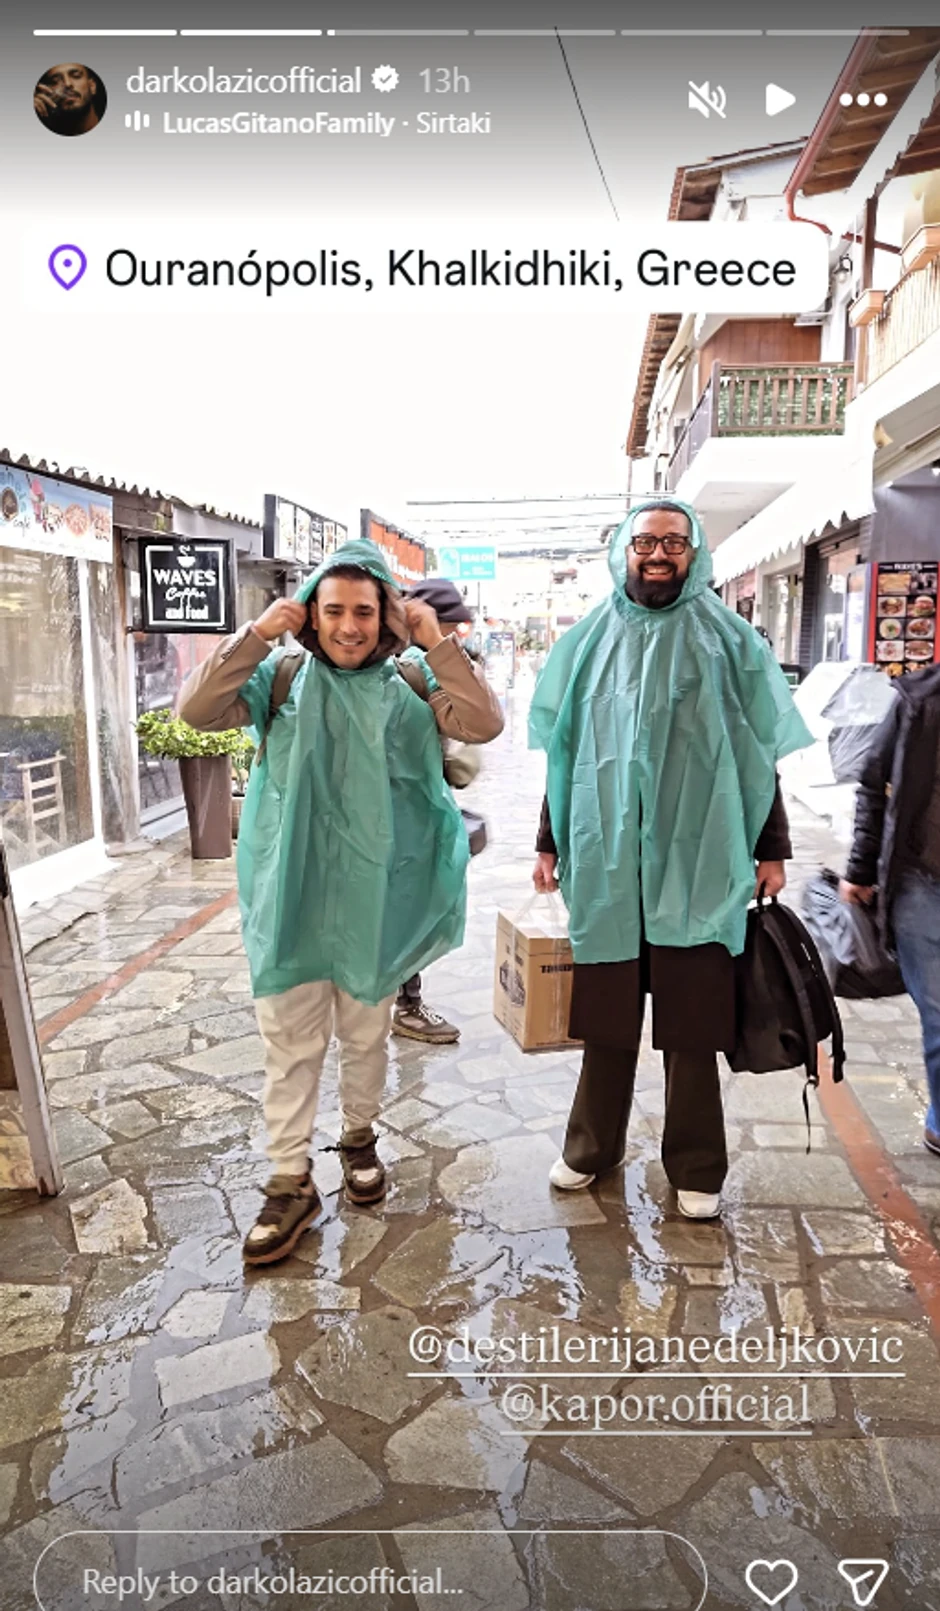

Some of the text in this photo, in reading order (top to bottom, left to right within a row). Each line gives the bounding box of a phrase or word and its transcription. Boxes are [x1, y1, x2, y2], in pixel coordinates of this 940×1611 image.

[153, 569, 216, 586] WAVES
[165, 587, 207, 606] Coffee
[165, 605, 209, 619] and food
